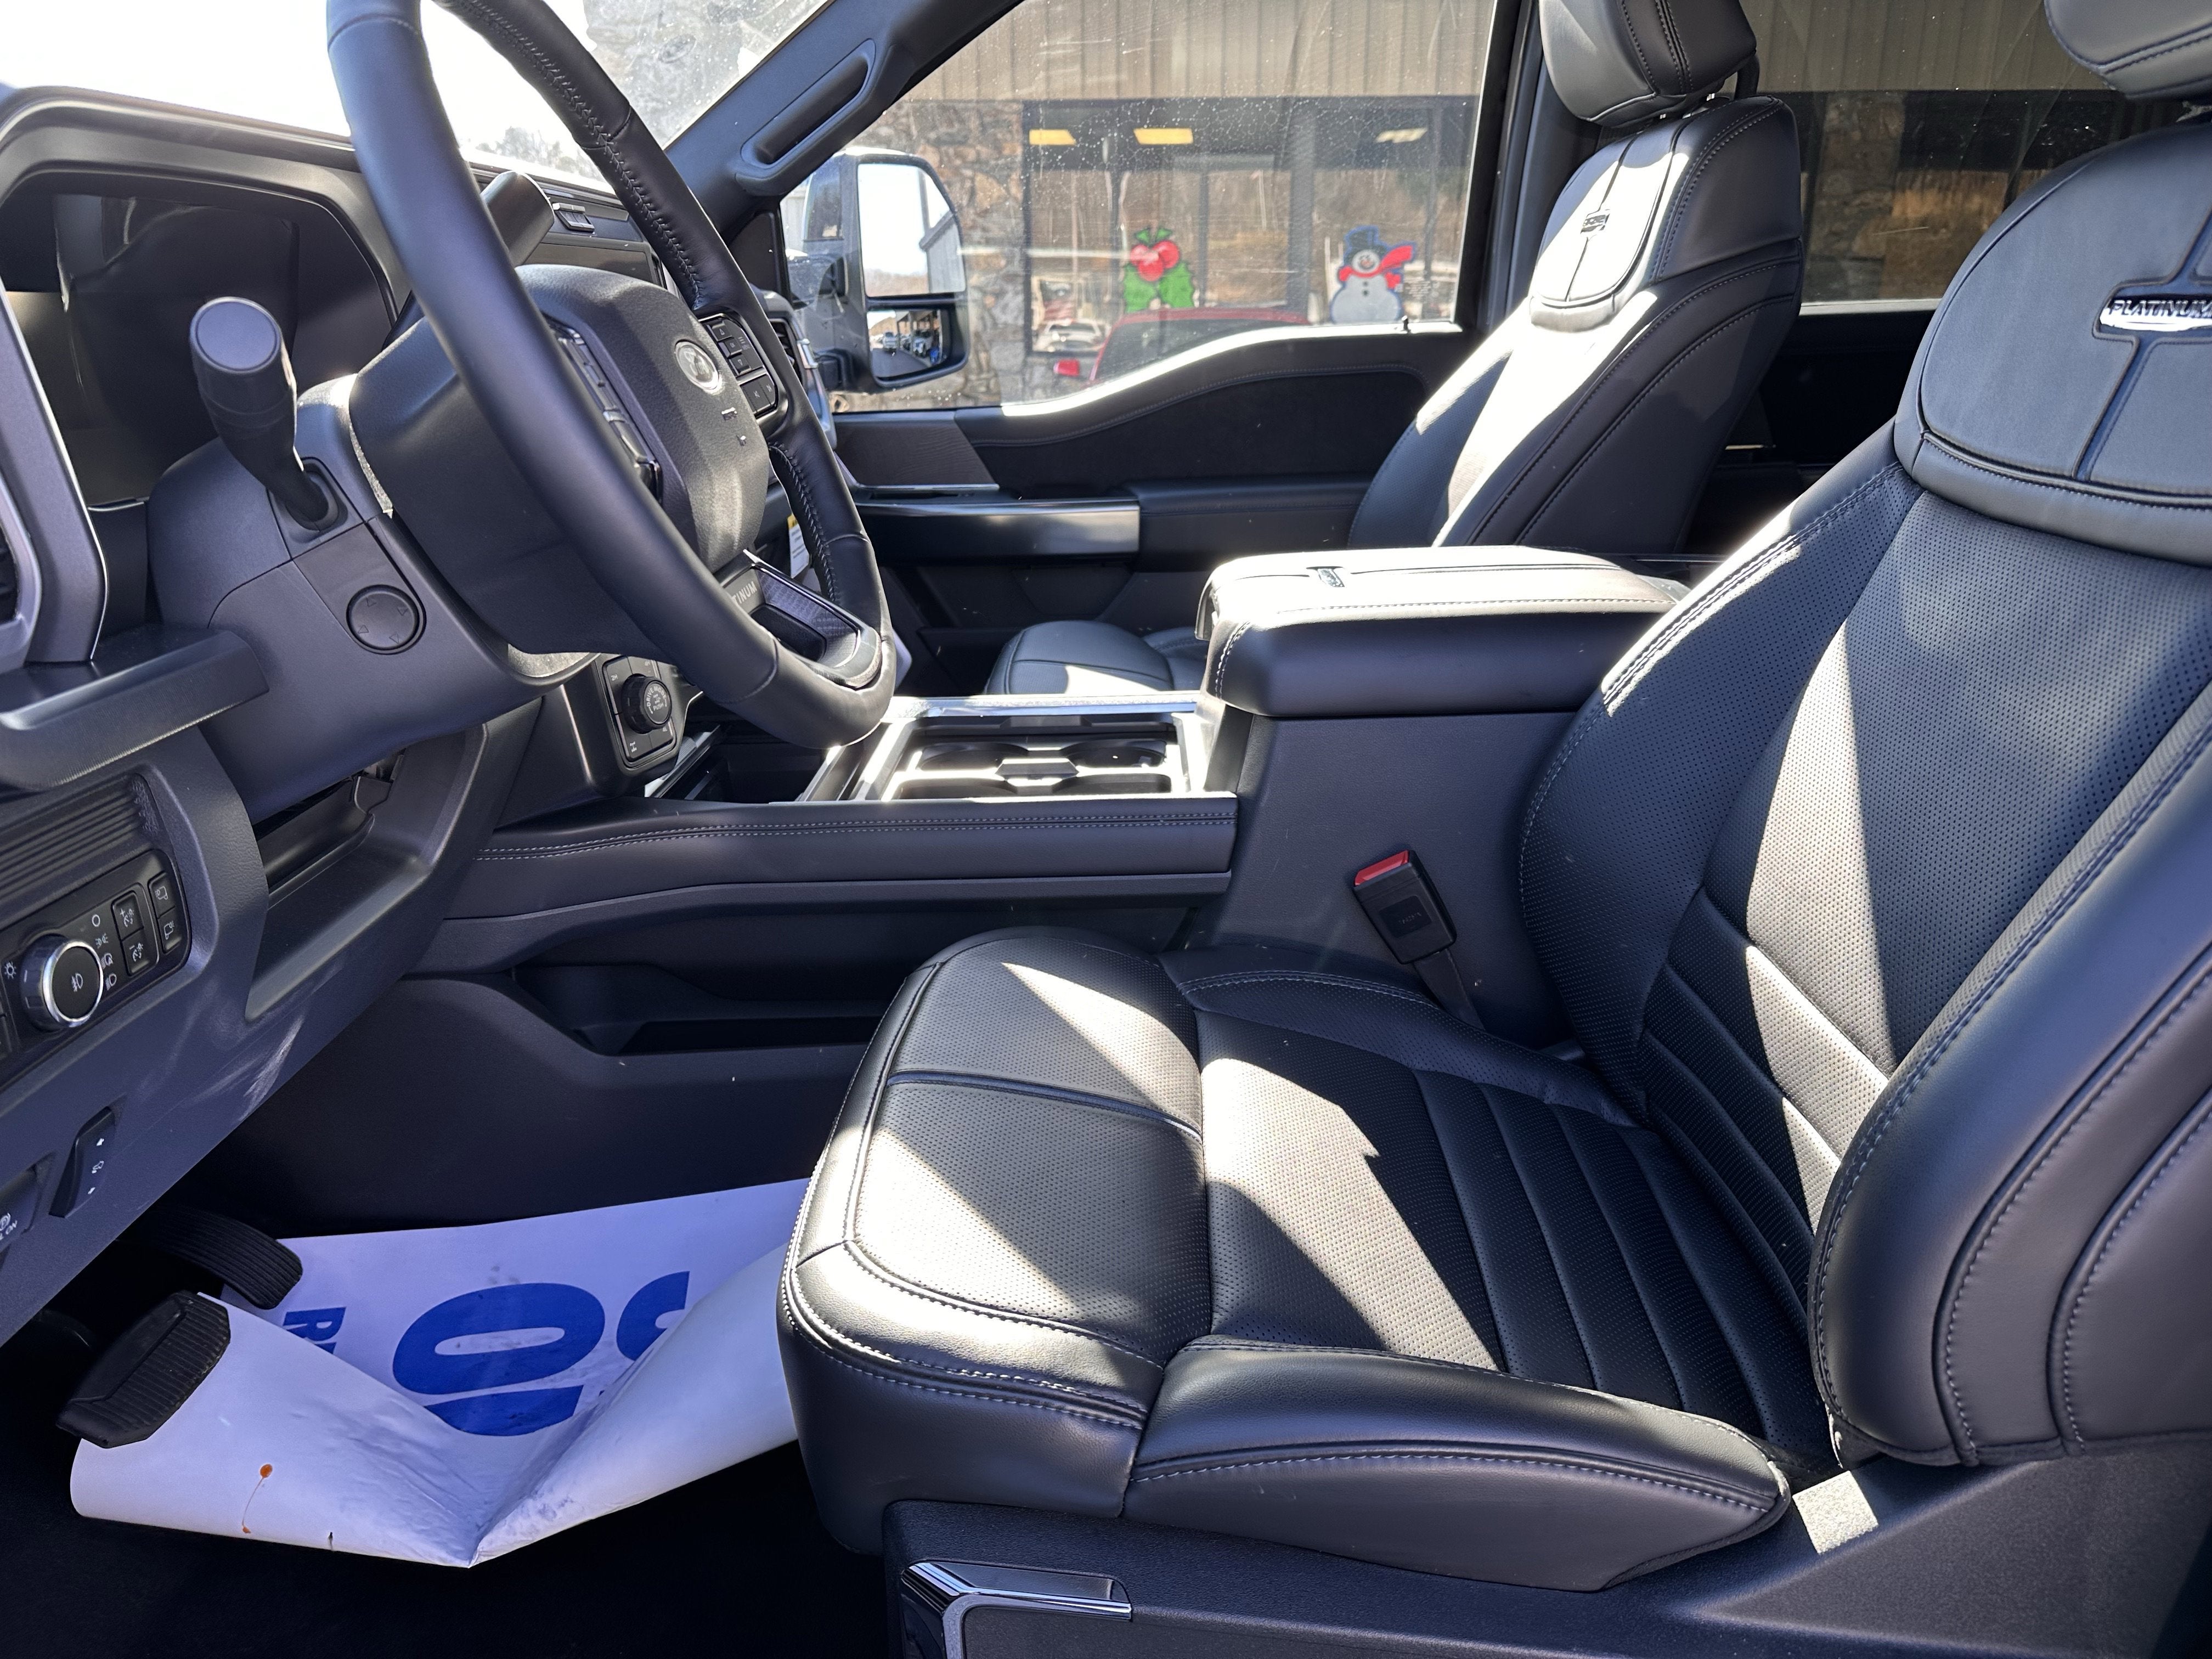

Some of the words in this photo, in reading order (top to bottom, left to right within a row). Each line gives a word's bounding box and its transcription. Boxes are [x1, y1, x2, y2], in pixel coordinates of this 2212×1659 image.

[2109, 300, 2212, 319] PLATINUM
[731, 581, 758, 605] TINUM
[646, 687, 654, 707] DRIVE
